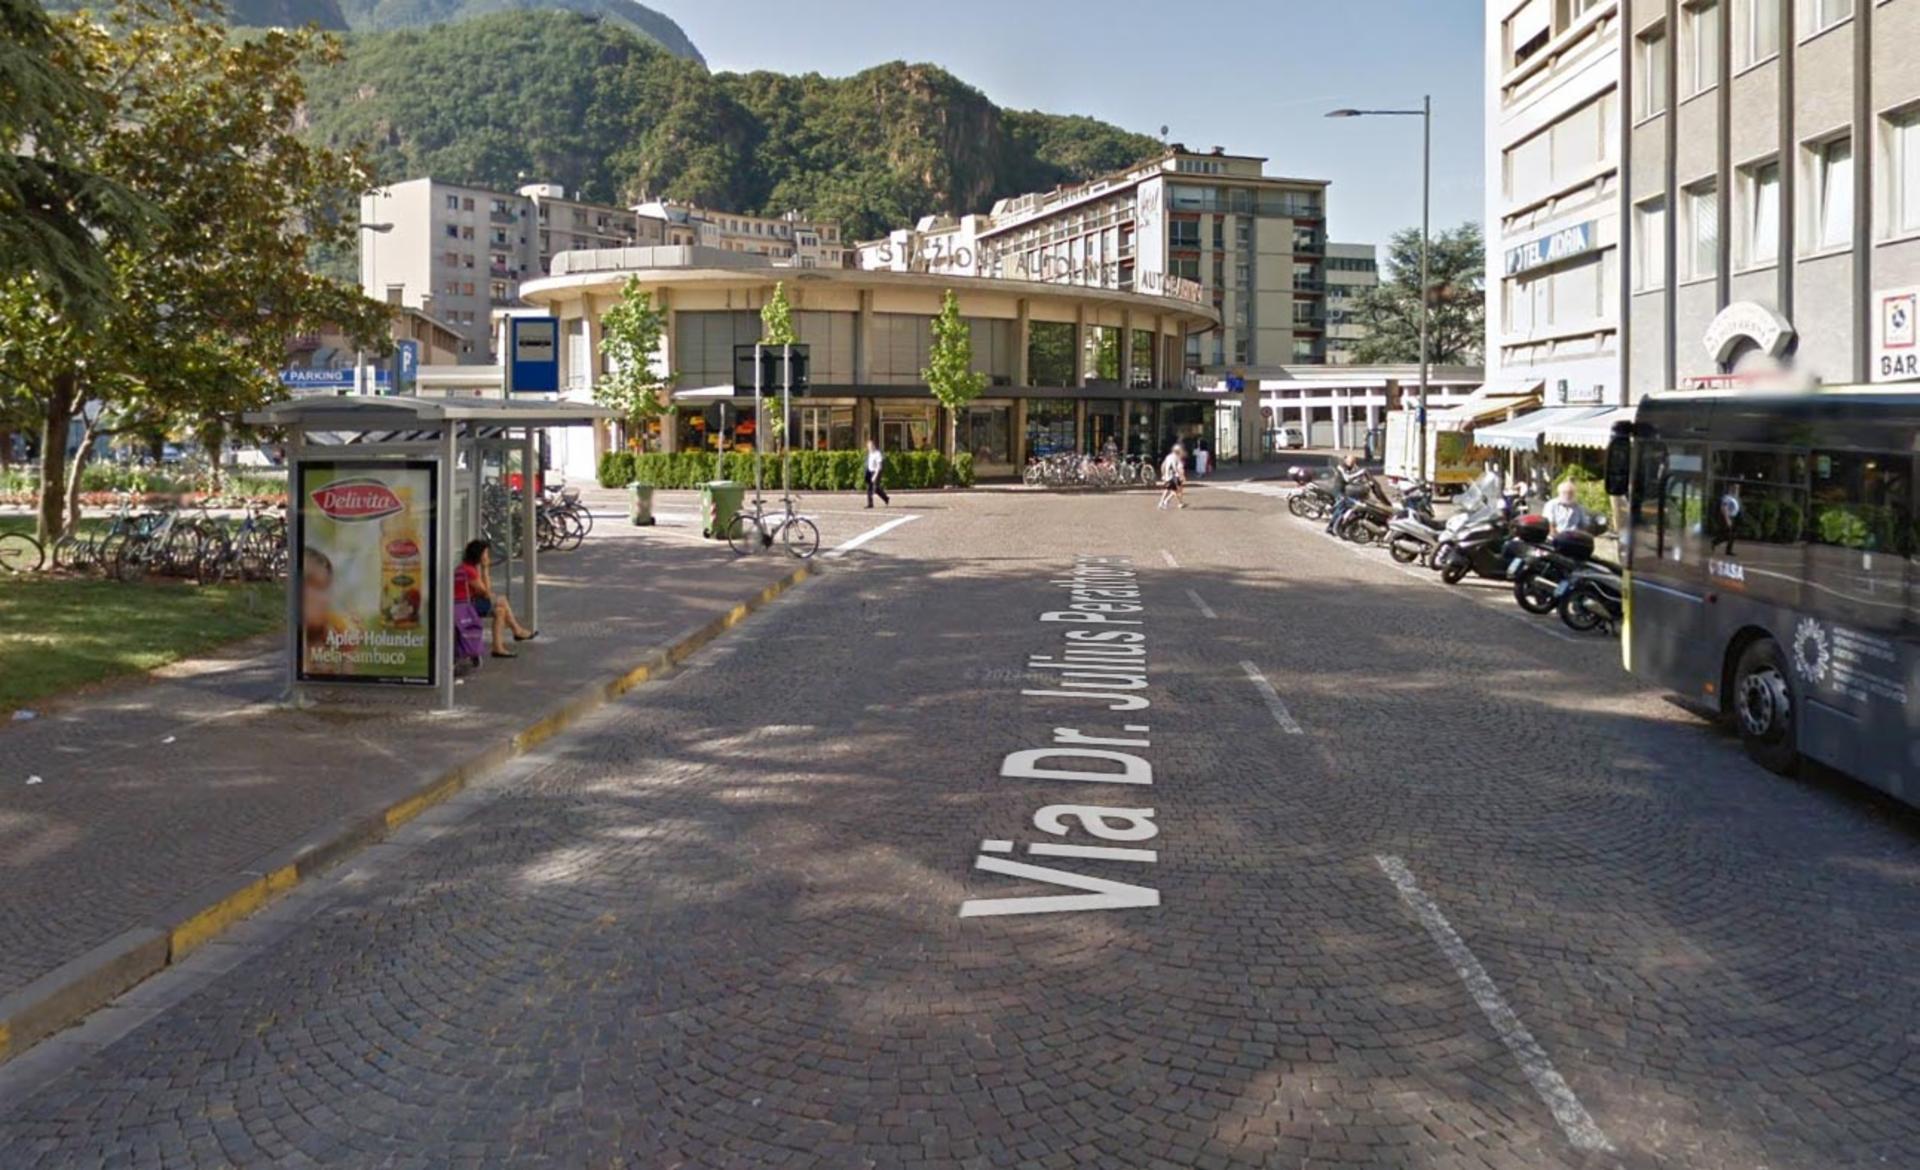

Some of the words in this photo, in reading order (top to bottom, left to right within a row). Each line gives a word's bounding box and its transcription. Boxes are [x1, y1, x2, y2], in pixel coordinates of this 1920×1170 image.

[1506, 242, 1542, 274] HOTEL
[1544, 226, 1587, 261] ADRIA
[1881, 353, 1918, 377] BAR
[290, 371, 343, 381] PARKING
[323, 490, 390, 509] Delivita
